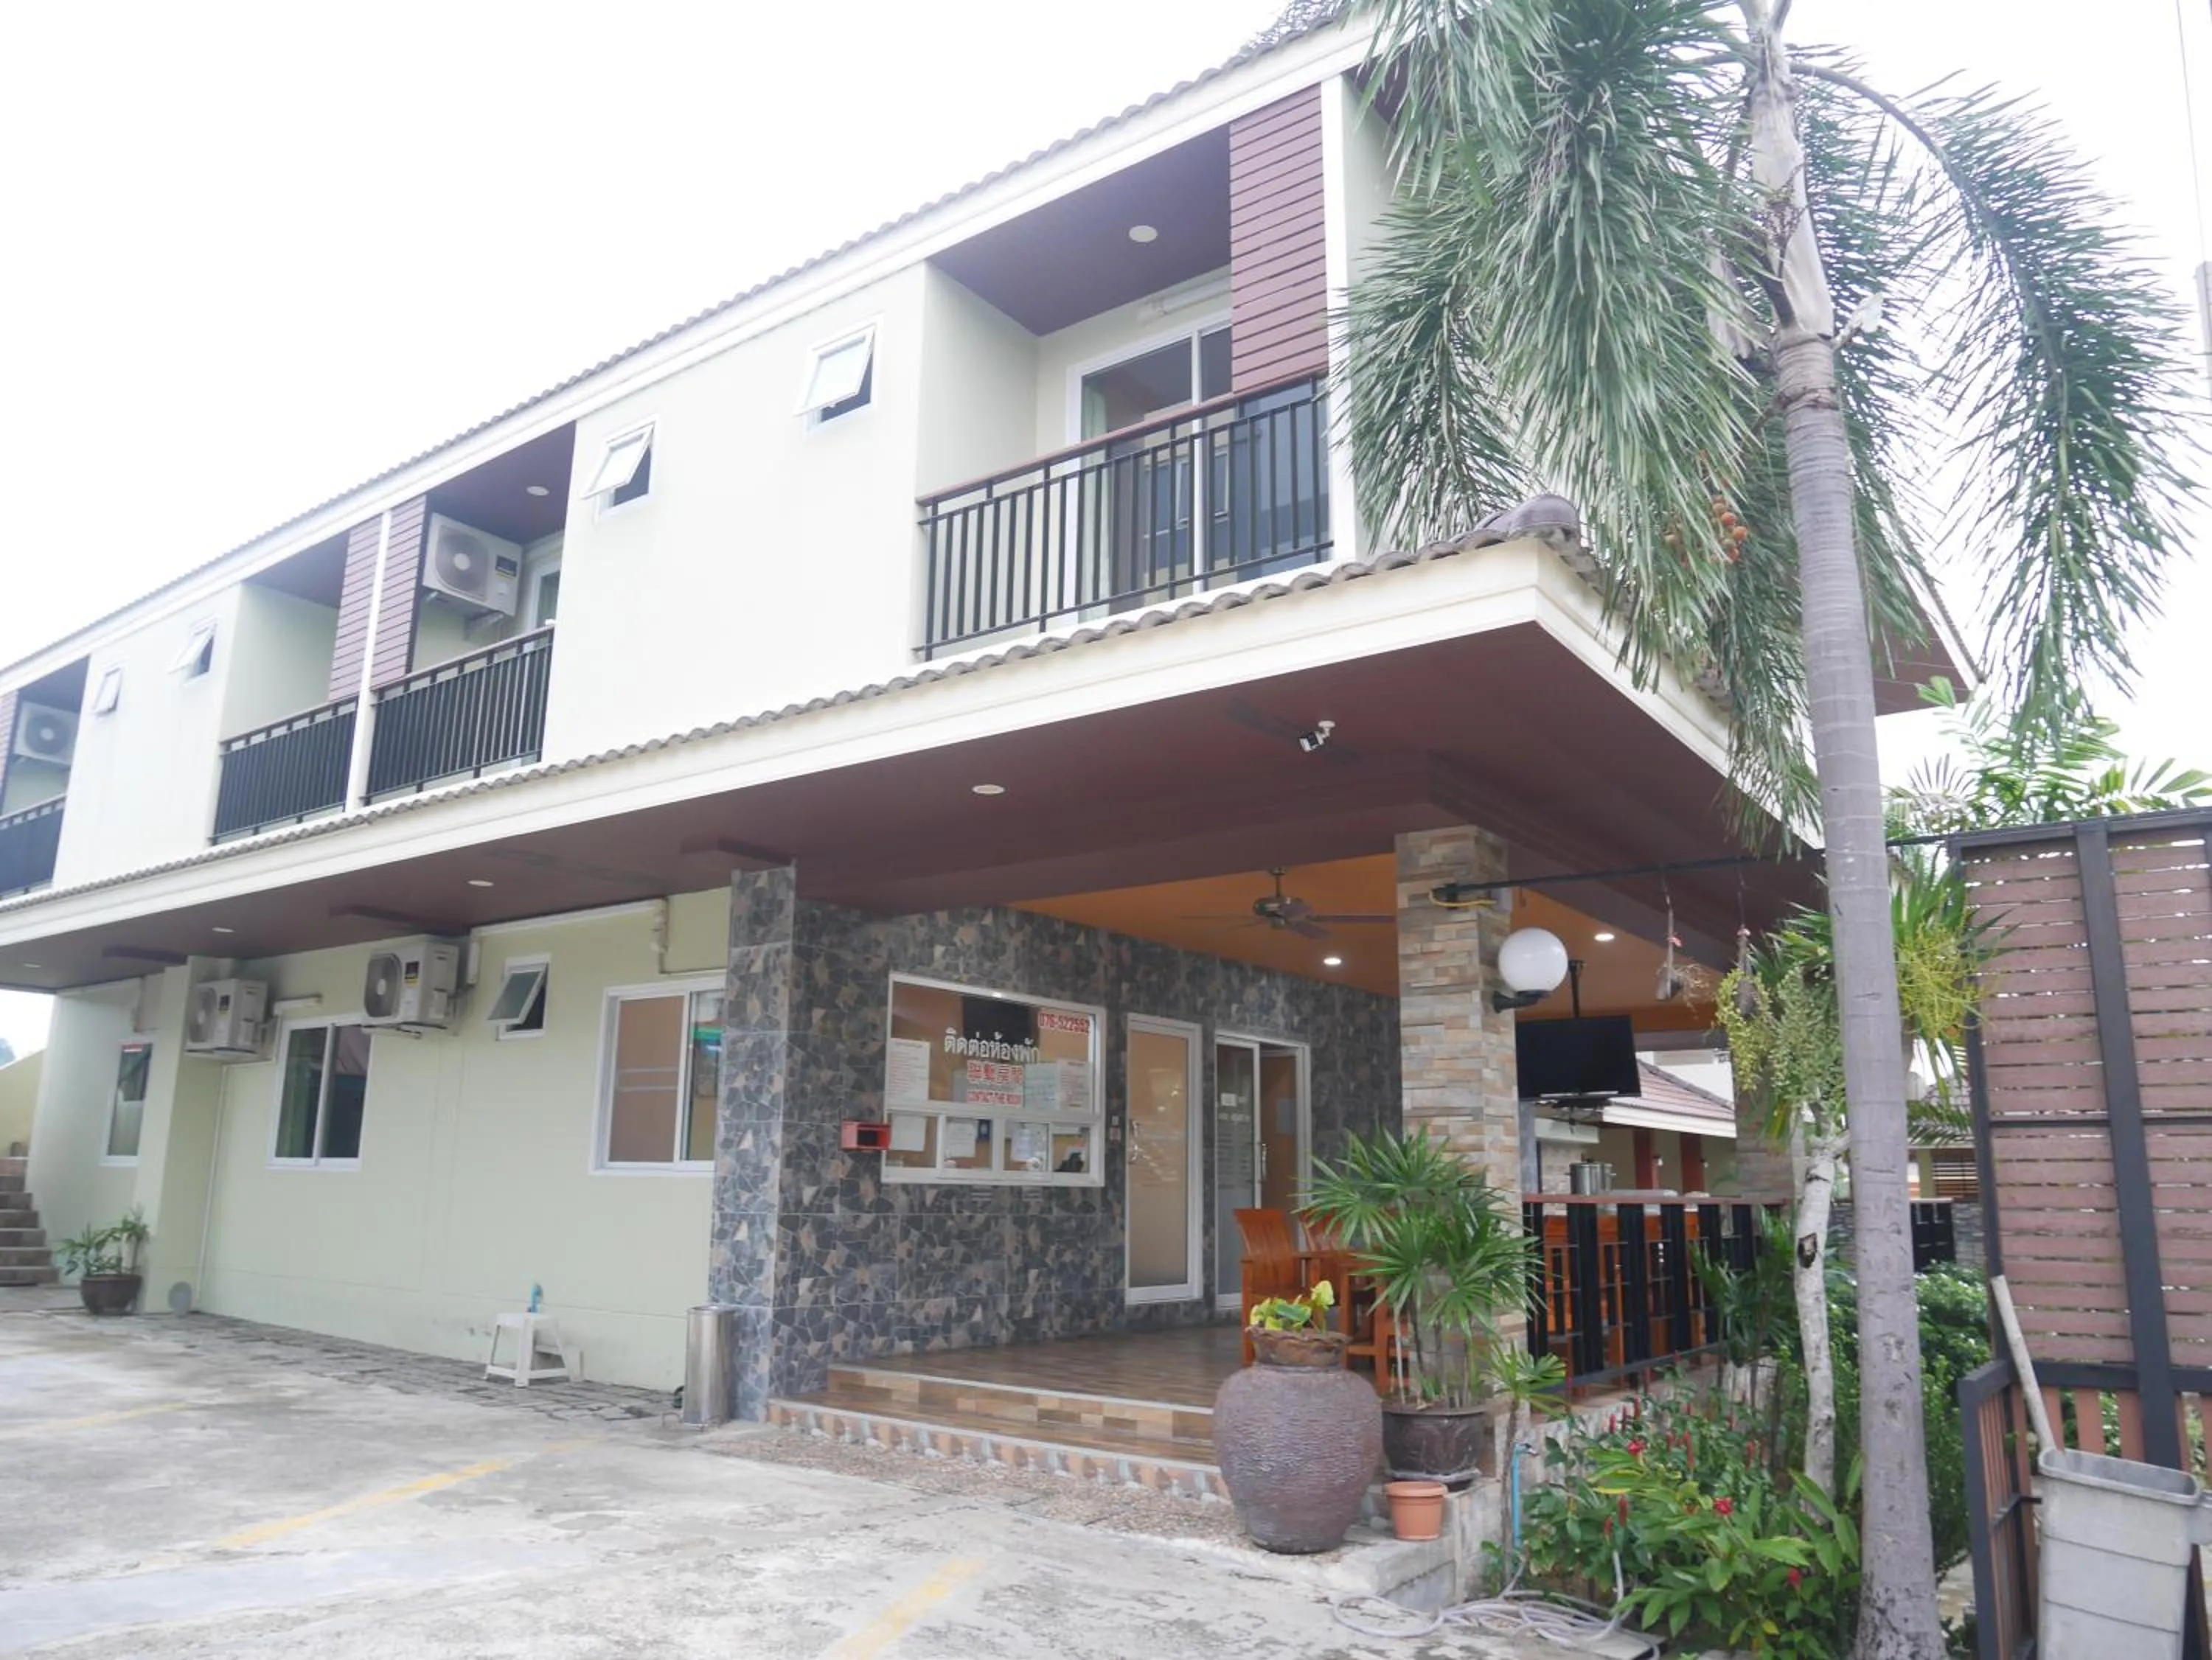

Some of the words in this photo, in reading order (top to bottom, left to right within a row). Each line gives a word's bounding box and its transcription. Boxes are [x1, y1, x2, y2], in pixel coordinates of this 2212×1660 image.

[944, 1026, 1040, 1064] ติดต่อห้องพัก
